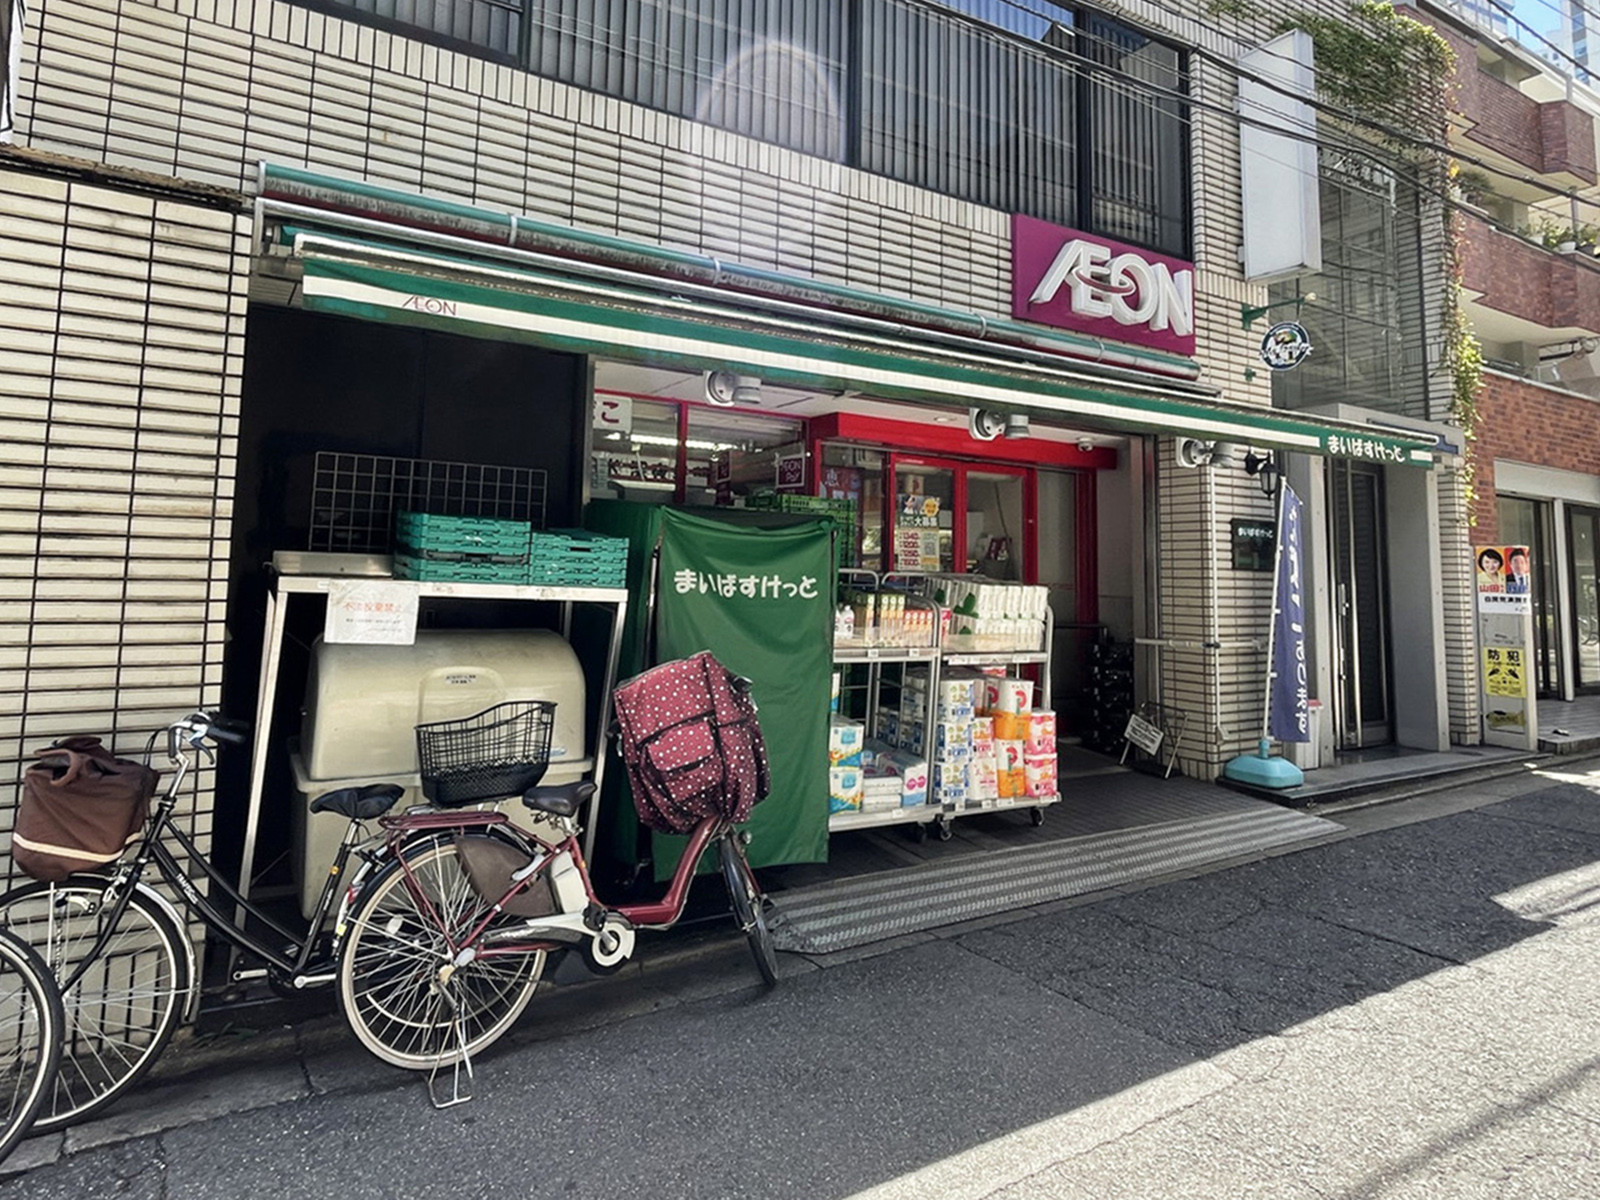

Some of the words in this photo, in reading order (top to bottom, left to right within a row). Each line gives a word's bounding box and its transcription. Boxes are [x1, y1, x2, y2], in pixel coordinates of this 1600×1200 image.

[1327, 434, 1405, 463] まいばすけっと
[674, 568, 818, 599] まいばすけっと
